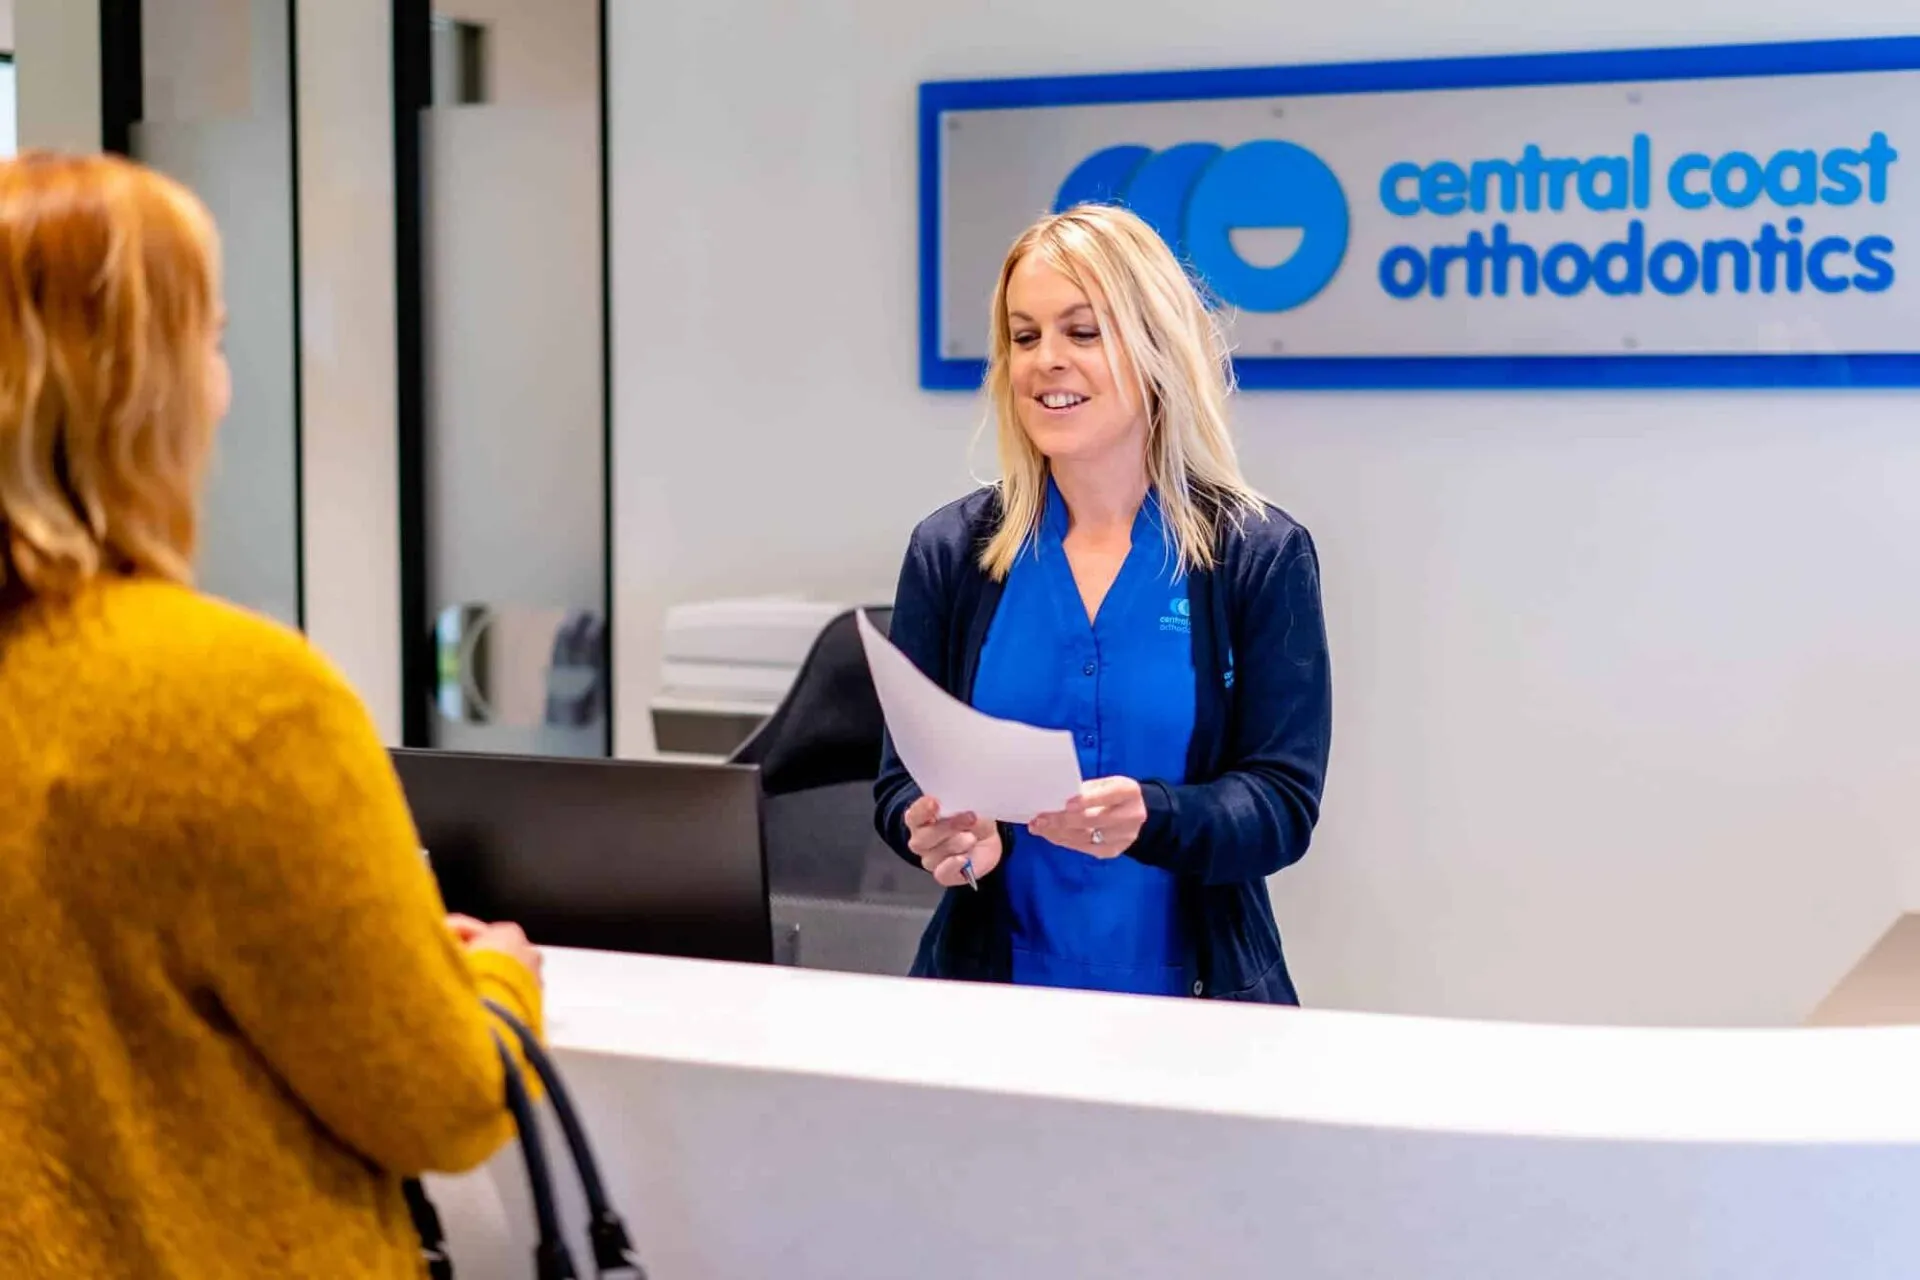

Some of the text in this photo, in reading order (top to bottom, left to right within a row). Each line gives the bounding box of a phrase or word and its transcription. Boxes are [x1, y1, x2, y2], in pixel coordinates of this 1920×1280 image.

[1379, 131, 1899, 216] central coast
[1378, 217, 1896, 299] orthodontics
